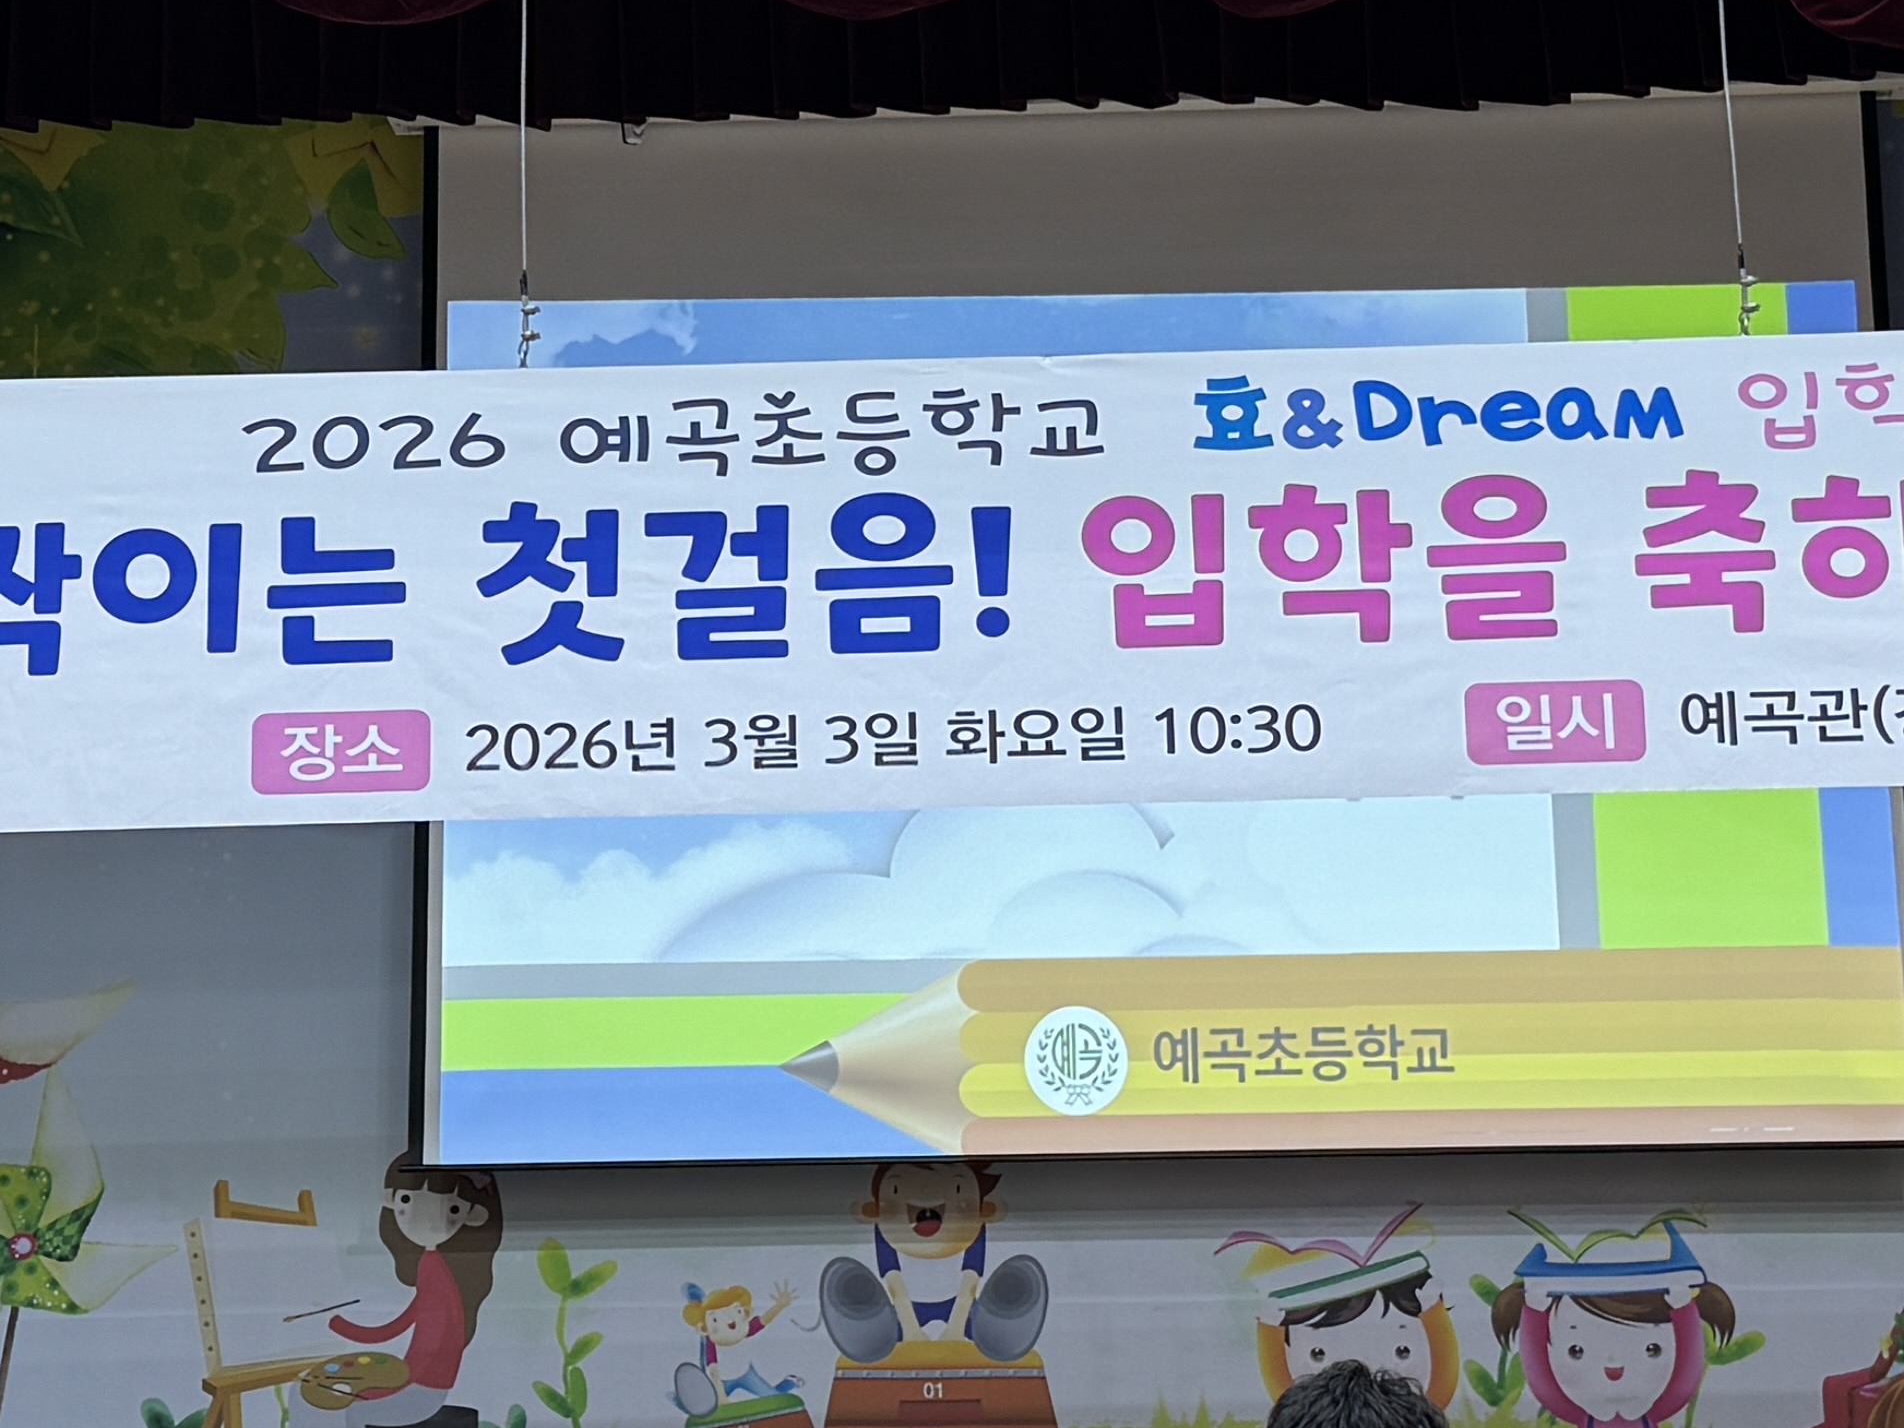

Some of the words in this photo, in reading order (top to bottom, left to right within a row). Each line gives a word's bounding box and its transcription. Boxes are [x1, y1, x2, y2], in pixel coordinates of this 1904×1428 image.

[241, 413, 508, 476] 2026
[560, 387, 1106, 479] 예곡초등학교
[1193, 375, 1686, 453] 효&Dream
[476, 492, 1014, 668] 첫걸음!
[1081, 476, 1570, 651] 입학을
[283, 726, 403, 781] 장소
[466, 718, 677, 774] 2026년
[705, 715, 800, 771] 3월
[825, 712, 920, 768] 3일
[946, 706, 1127, 766] 화요일
[1154, 704, 1324, 757] 10:30
[1497, 694, 1616, 751] 일시
[1154, 1023, 1457, 1085] 예곡초등학교
[923, 1382, 944, 1399] 01
